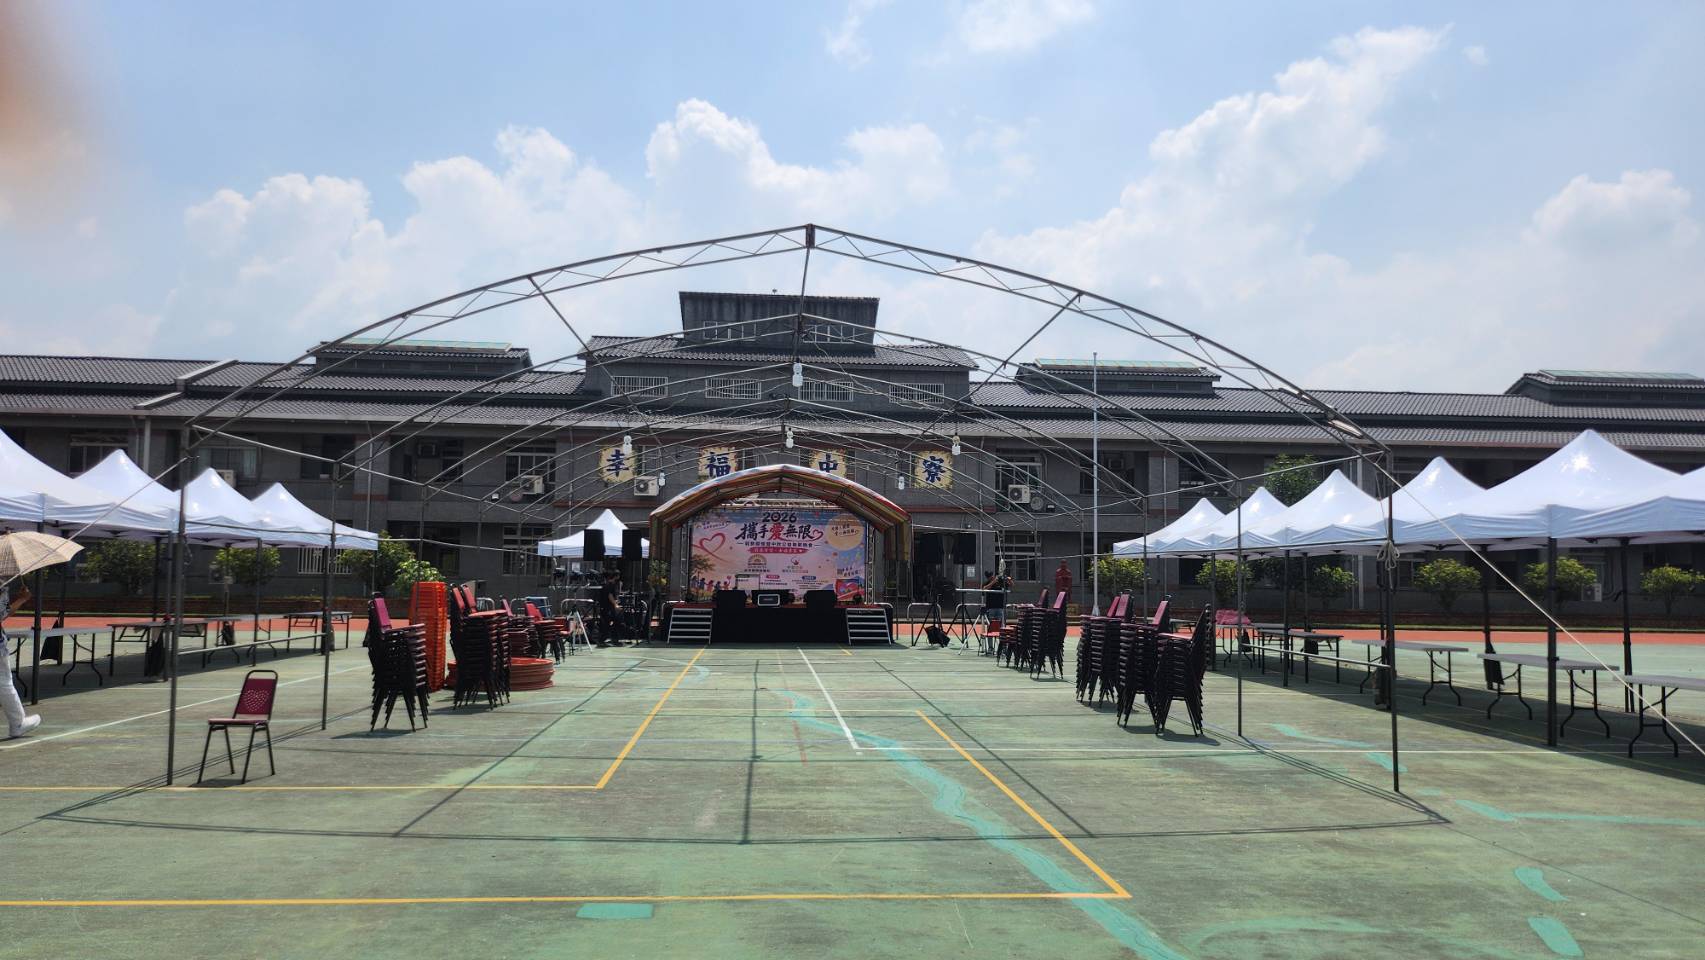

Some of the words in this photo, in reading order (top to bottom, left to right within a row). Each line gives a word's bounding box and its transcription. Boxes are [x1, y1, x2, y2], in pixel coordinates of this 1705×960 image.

[705, 451, 731, 477] 福
[818, 453, 839, 473] 中
[922, 455, 946, 483] 寮
[762, 512, 797, 523] 2026
[735, 522, 816, 541] 攜手愛無限
